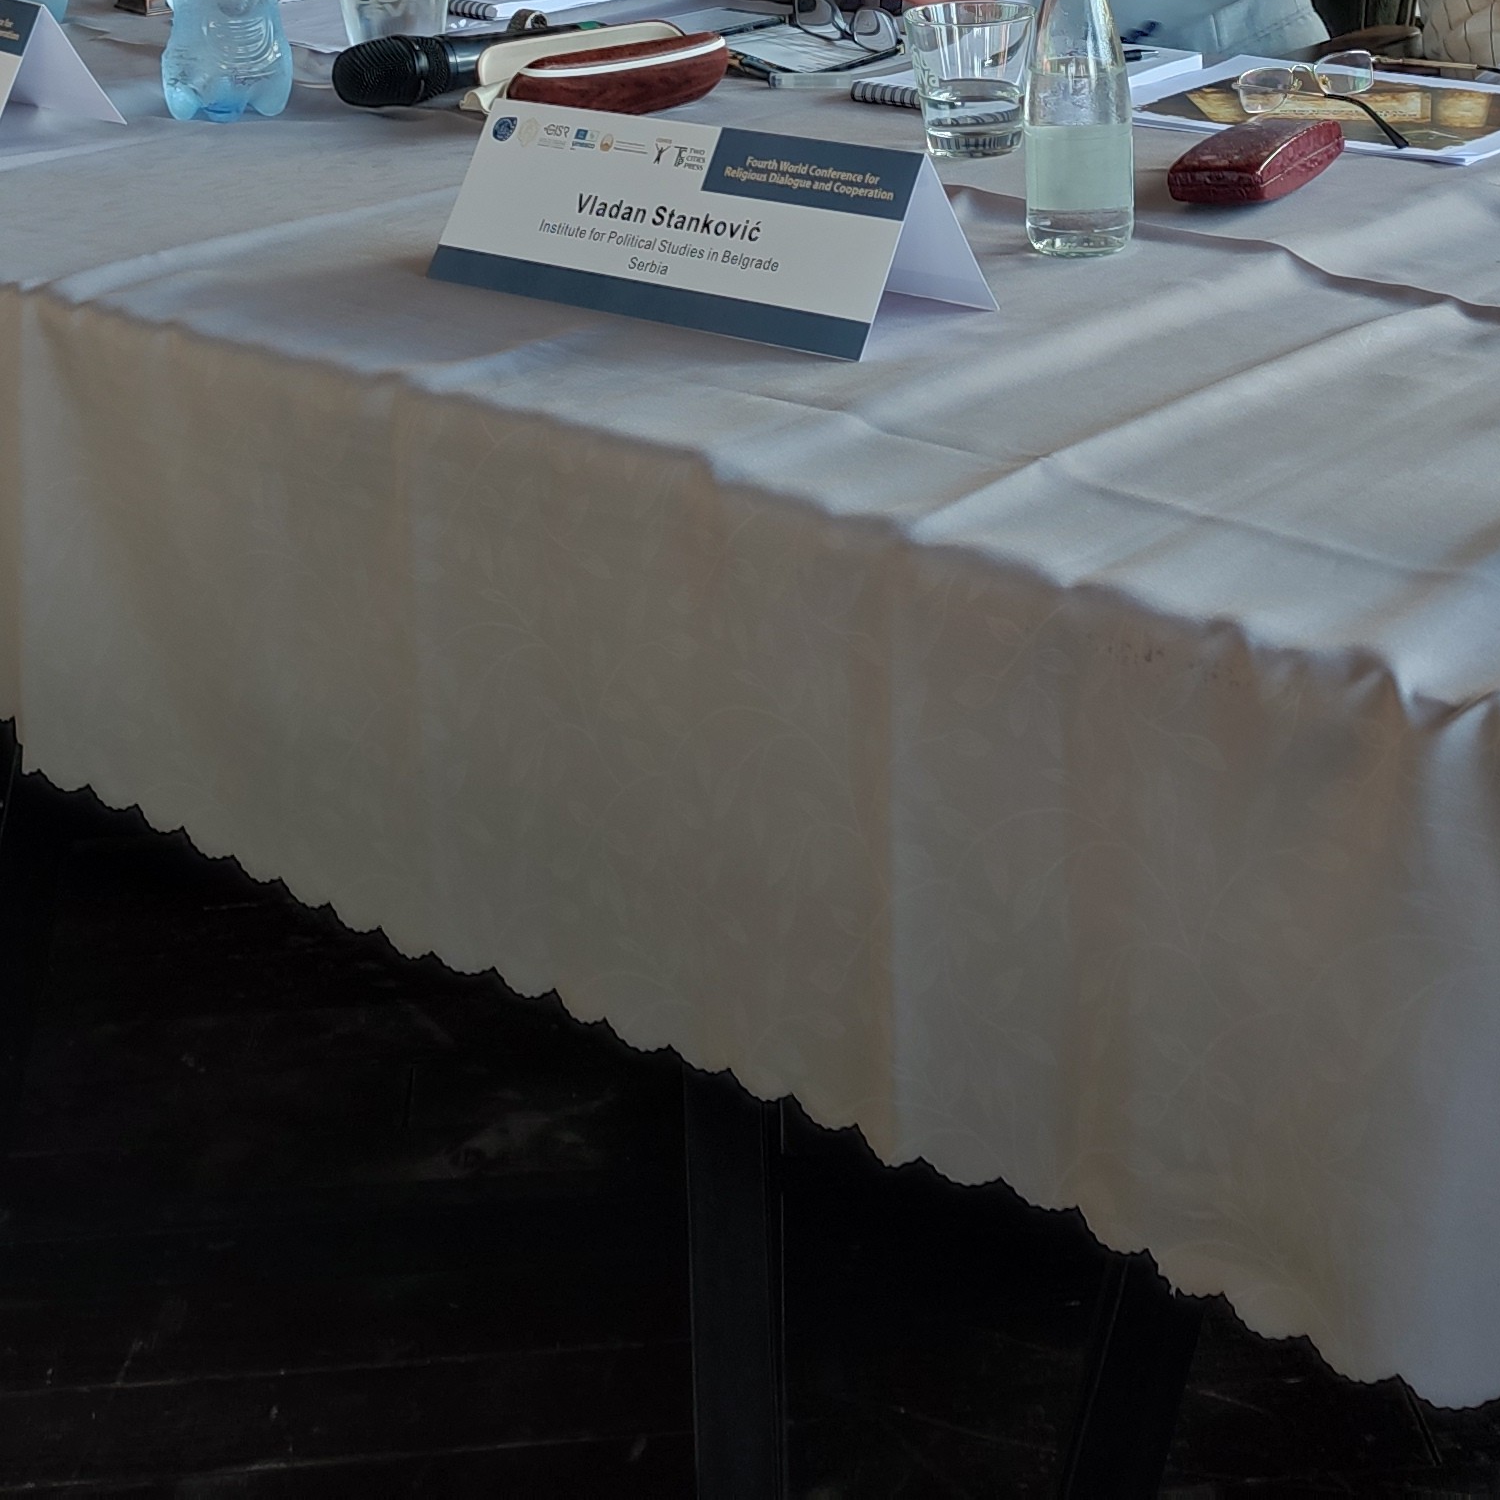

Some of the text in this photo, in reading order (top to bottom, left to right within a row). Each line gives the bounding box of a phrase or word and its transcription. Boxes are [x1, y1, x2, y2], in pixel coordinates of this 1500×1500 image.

[724, 166, 895, 201] Religious Dialogue and Cooperation
[746, 156, 881, 185] Fourth World Conference for
[576, 193, 762, 242] Vladan Stanković
[538, 219, 780, 272] Institute for Political Studies in Belgrade
[628, 257, 669, 276] Serbia
